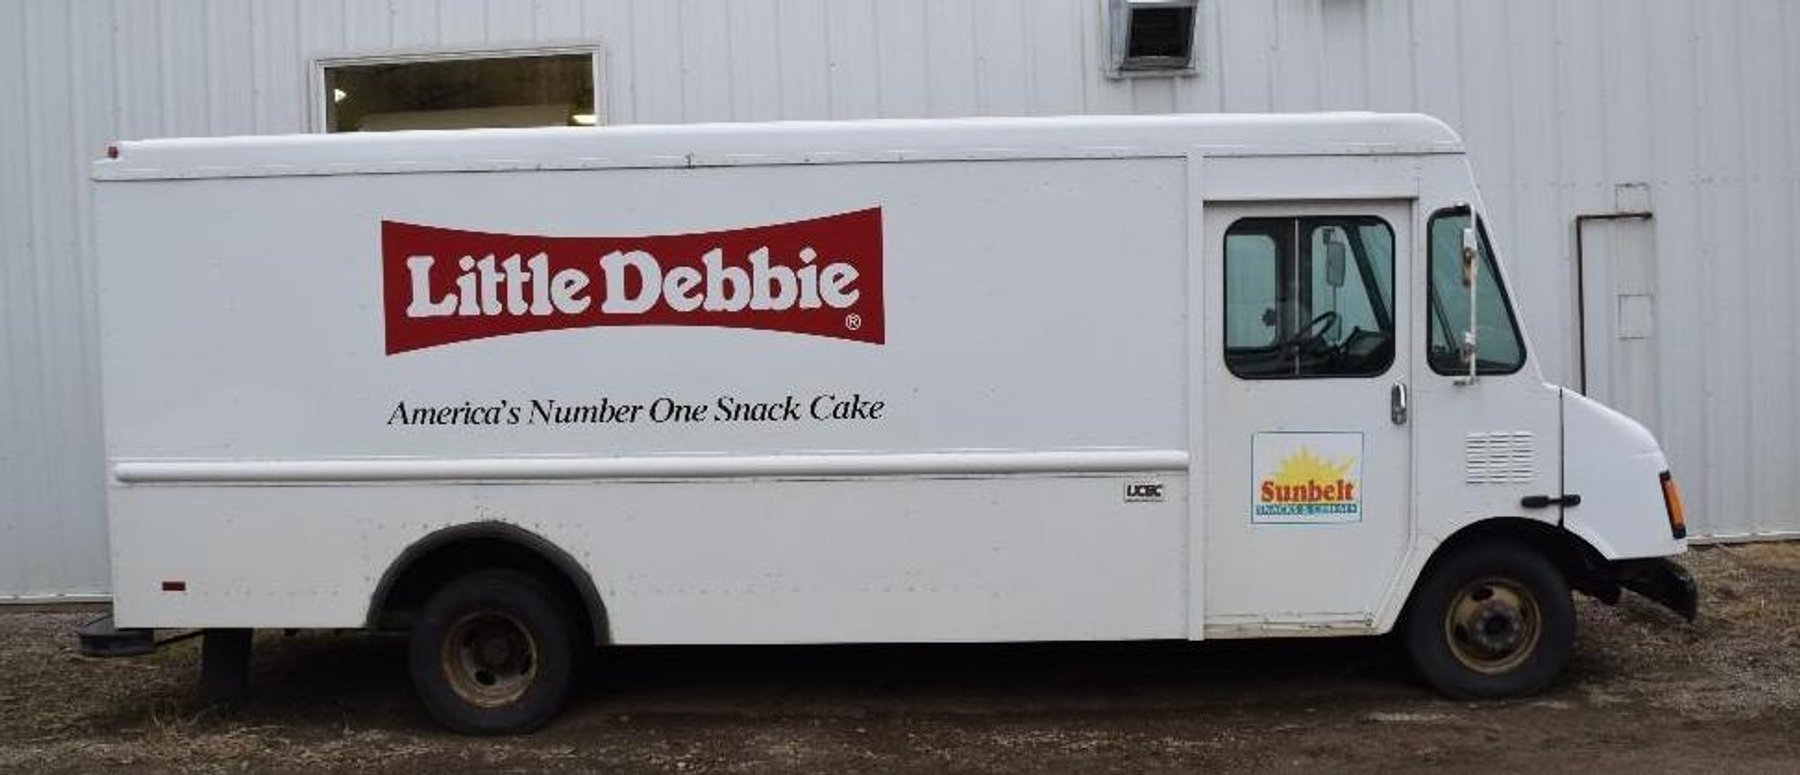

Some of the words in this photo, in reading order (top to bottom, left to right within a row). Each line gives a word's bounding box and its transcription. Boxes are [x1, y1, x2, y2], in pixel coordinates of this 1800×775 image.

[406, 252, 591, 317] Little
[600, 246, 859, 313] Debbie
[387, 400, 521, 425] America's
[529, 398, 643, 424] Number
[649, 397, 708, 423] One
[714, 395, 801, 421] Snack
[810, 394, 885, 420] Cake
[1261, 480, 1354, 502] Sunbelt
